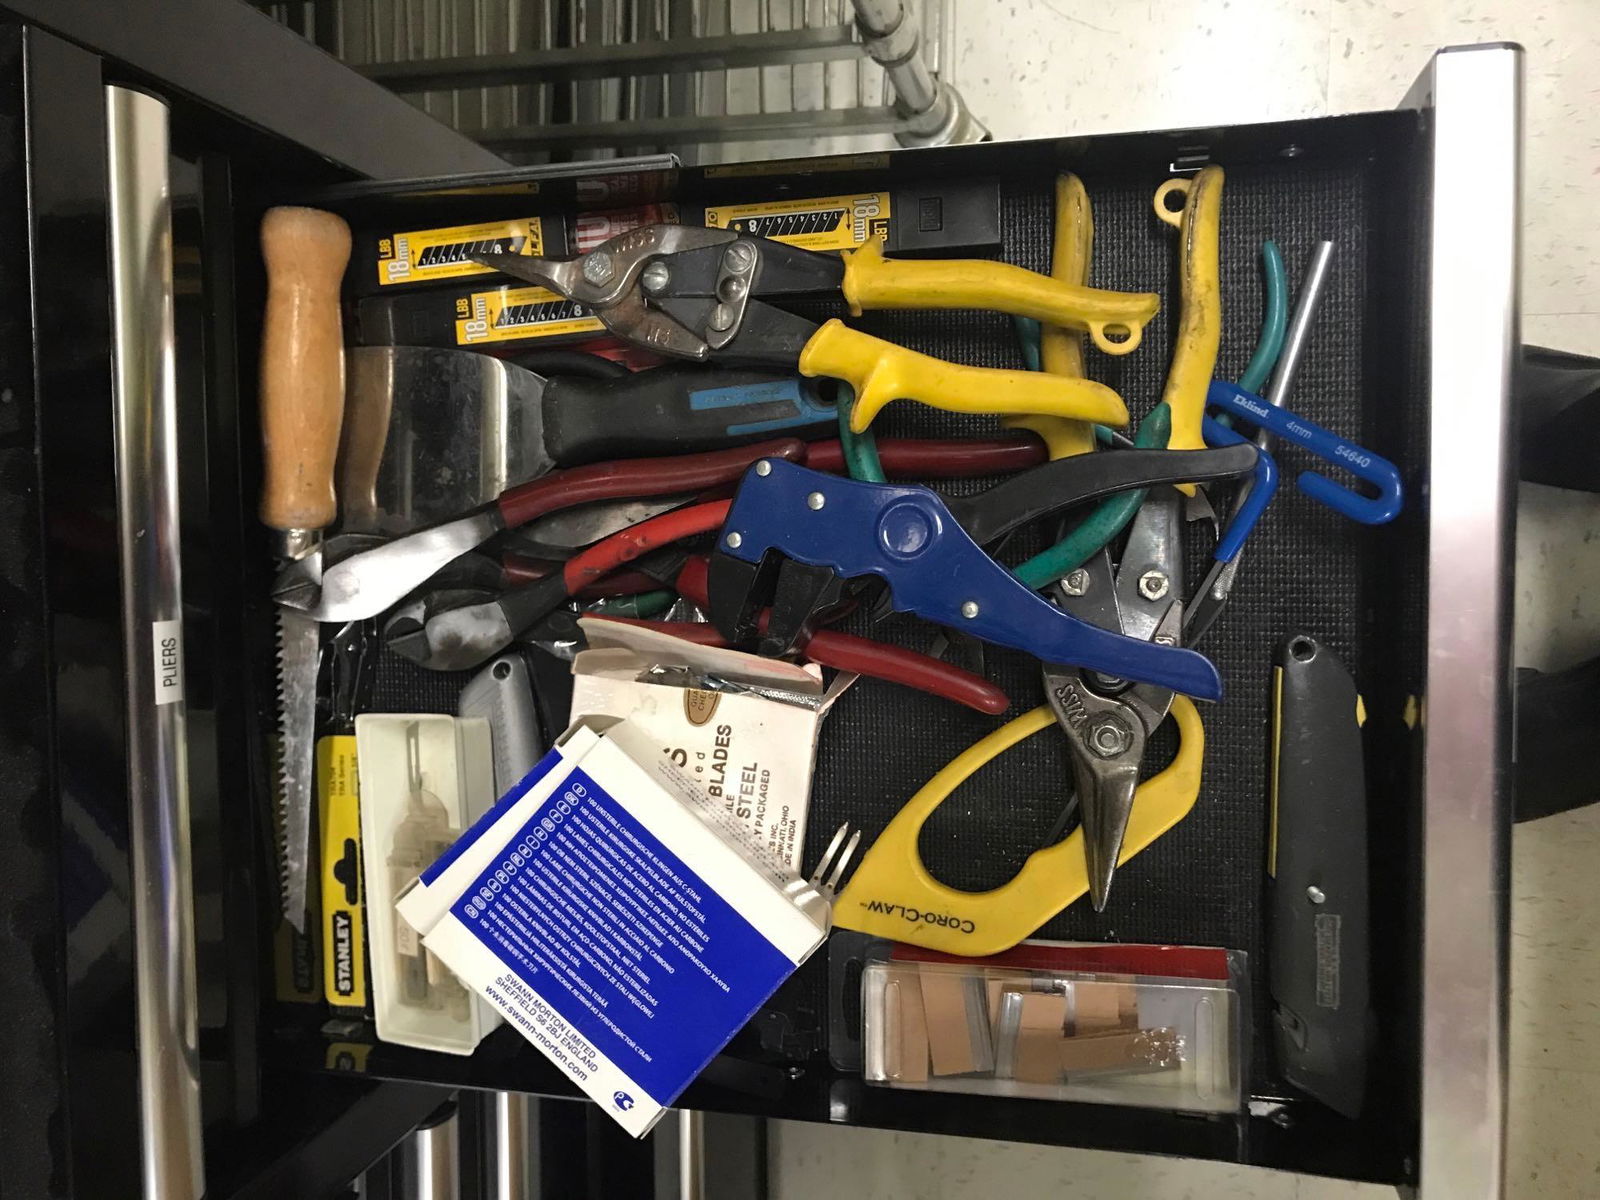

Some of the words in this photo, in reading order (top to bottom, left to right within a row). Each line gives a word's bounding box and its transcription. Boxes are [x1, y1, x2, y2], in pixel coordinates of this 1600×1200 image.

[853, 194, 880, 242] 18mm
[378, 238, 392, 258] LBB
[388, 238, 410, 282] 18mm
[456, 298, 470, 318] LBB
[465, 297, 489, 342] 18mm
[1286, 421, 1312, 439] 4mm
[1334, 444, 1371, 468] 54640
[161, 638, 178, 688] PLIERS
[708, 724, 732, 798] BLADES
[736, 762, 758, 820] STEEL
[756, 769, 770, 826] PACKAGED
[781, 805, 790, 826] OHIO
[555, 831, 567, 843] 100
[562, 822, 574, 834] 100
[788, 819, 796, 837] INDIA
[539, 848, 551, 860] 100
[547, 840, 558, 851] 100
[570, 813, 582, 825] 100
[578, 821, 597, 839] HOJAS
[631, 869, 650, 887] ACERO
[578, 804, 590, 816] 100
[666, 886, 676, 896] AF
[586, 796, 598, 808] 100
[594, 803, 621, 829] UNSTERILE
[651, 855, 674, 877] KLINGEN
[670, 874, 684, 886] AUS
[680, 882, 702, 904] C-STAHL
[523, 866, 535, 878] 100
[531, 857, 543, 869] 100
[508, 883, 520, 895] 100
[516, 875, 528, 886] 100
[493, 901, 505, 912] 100
[500, 892, 512, 904] 100
[478, 917, 490, 930] 100
[485, 909, 498, 921] 100
[336, 914, 352, 993] STANLEY
[494, 976, 537, 1016] SHEFFIELD
[535, 1013, 547, 1025] S6
[545, 1023, 561, 1039] 2BJ
[559, 1036, 598, 1072] ENGLAND
[504, 973, 534, 1001] SWANN
[531, 999, 566, 1031] MORTON
[564, 1029, 596, 1059] LIMITED
[483, 985, 589, 1081] www.swann-morton.com
